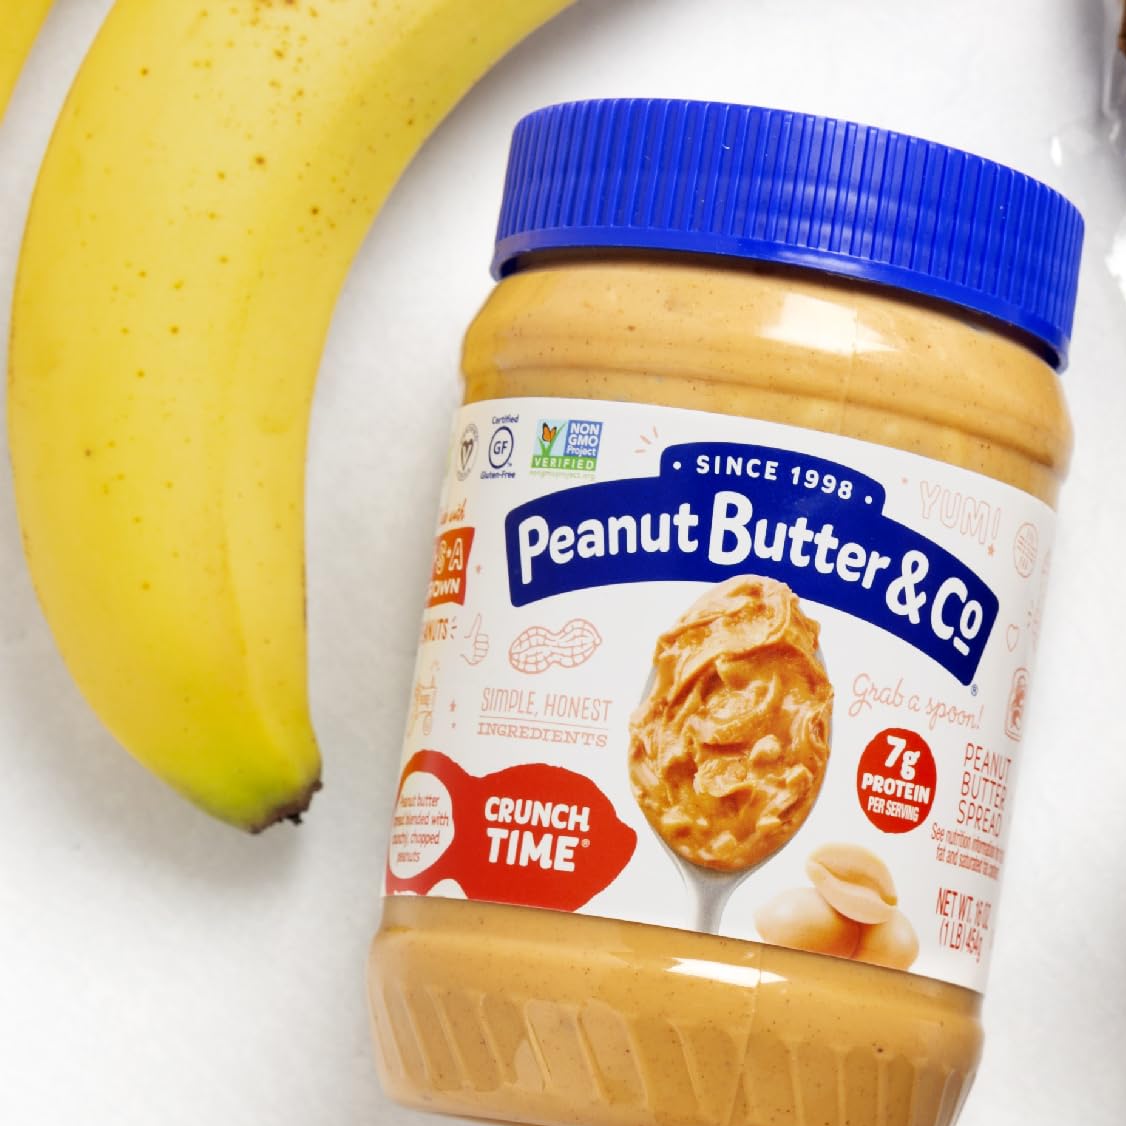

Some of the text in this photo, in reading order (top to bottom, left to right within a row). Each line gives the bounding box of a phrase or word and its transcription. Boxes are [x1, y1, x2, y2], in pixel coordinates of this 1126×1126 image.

[491, 414, 520, 425] Certified
[570, 422, 600, 436] NON
[493, 440, 509, 456] GF
[566, 446, 597, 457] Project
[568, 434, 599, 447] GMO
[480, 470, 517, 480] Gluten-Free
[533, 457, 595, 470] VERIFIED
[696, 455, 854, 500] SINCE 1998
[919, 480, 1001, 546] YUM!
[518, 503, 700, 585] Peanut
[707, 490, 891, 590] Butter
[480, 687, 613, 722] SIMPLE, HONEST
[848, 672, 985, 730] Grab a spoon!
[476, 721, 609, 748] INGREDIENTS
[884, 734, 921, 781] 7g
[963, 742, 1013, 782] PEANUT
[861, 771, 931, 804] PROTEIN
[960, 771, 1008, 812] BUTTER
[484, 796, 591, 832] CRUNCH
[867, 795, 920, 823] PER SERVING
[956, 799, 1003, 838] SPREAD
[931, 822, 946, 842] See
[935, 887, 958, 918] NET
